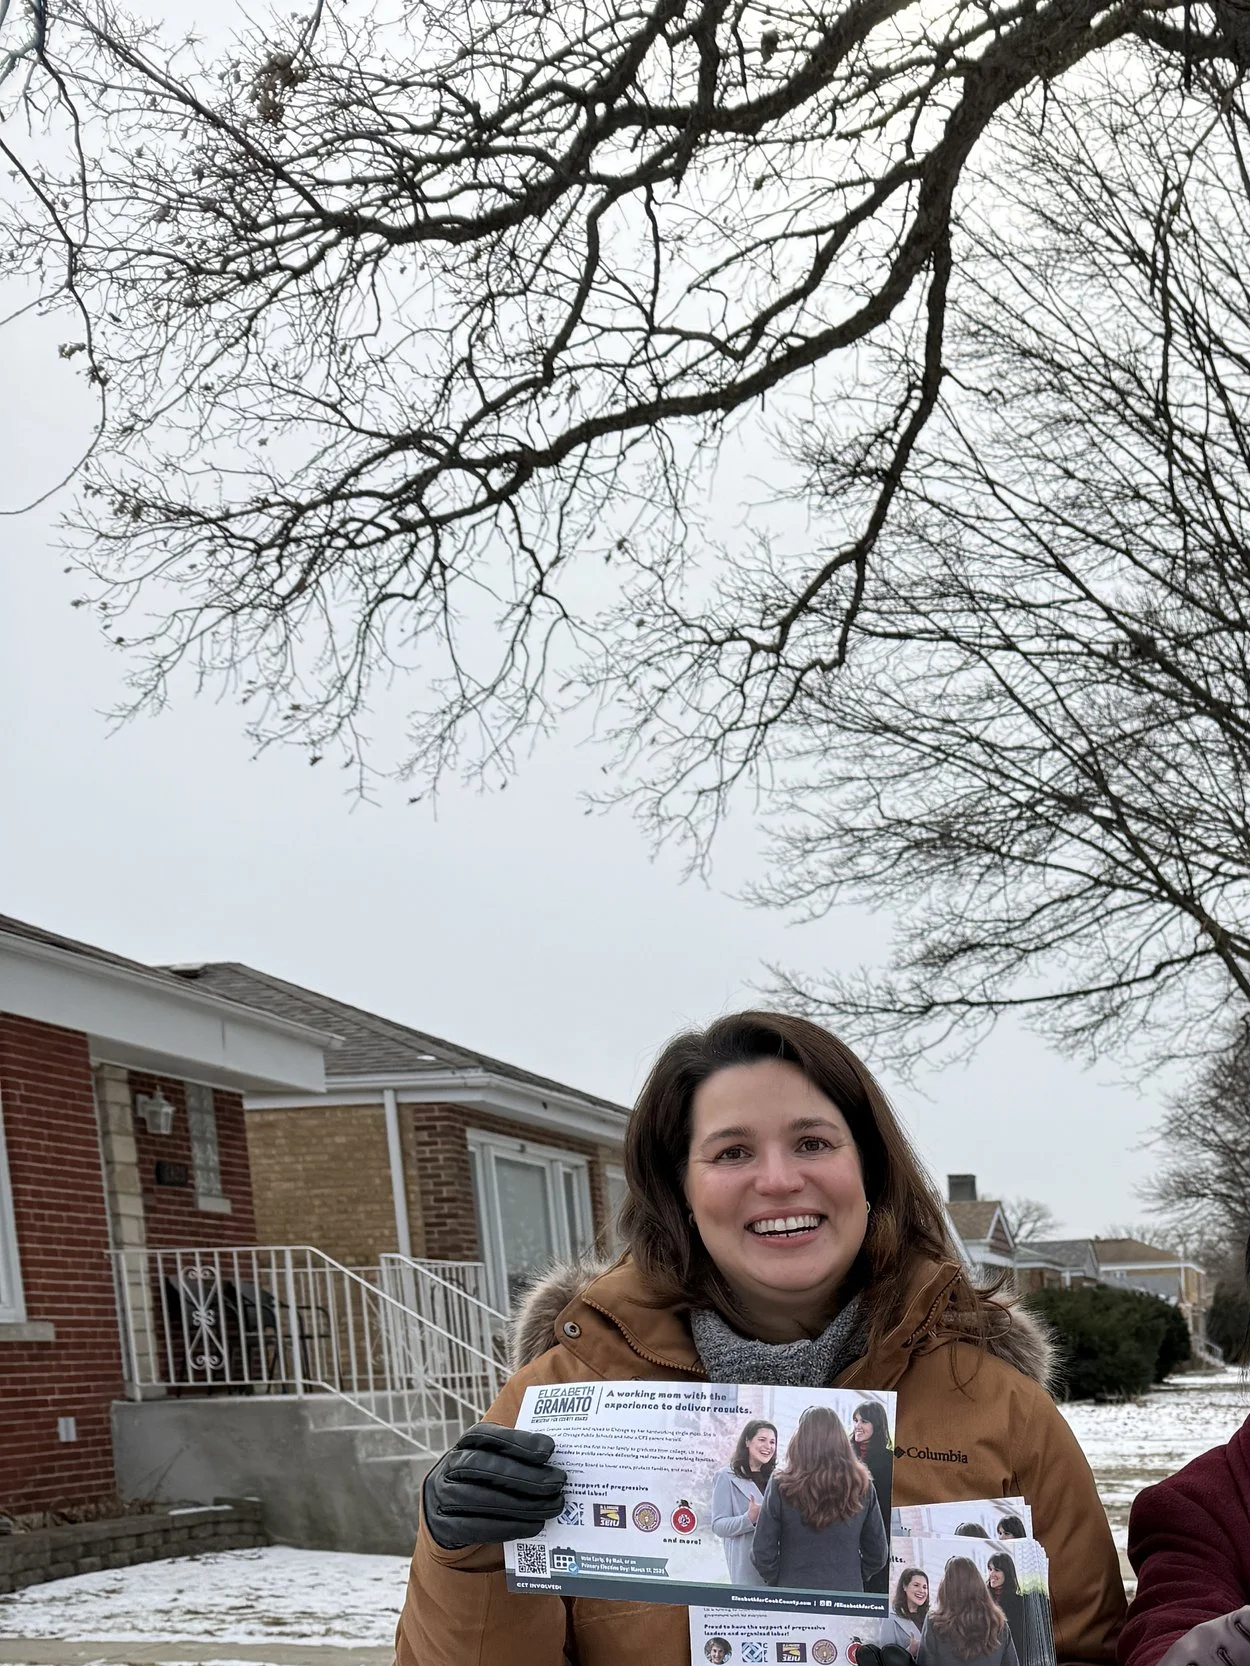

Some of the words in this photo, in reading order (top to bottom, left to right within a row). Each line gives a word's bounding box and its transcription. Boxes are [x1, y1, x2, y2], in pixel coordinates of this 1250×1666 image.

[537, 1386, 595, 1399] ELIZABETH
[606, 1389, 615, 1397] A
[617, 1390, 657, 1400] working
[658, 1392, 681, 1400] mom
[684, 1391, 707, 1400] with
[709, 1392, 727, 1401] the
[533, 1396, 593, 1415] GRANATO
[604, 1401, 659, 1411] experience
[661, 1403, 673, 1411] to
[674, 1402, 712, 1413] deliver
[713, 1405, 753, 1415] results.
[906, 1446, 969, 1464] Columbia
